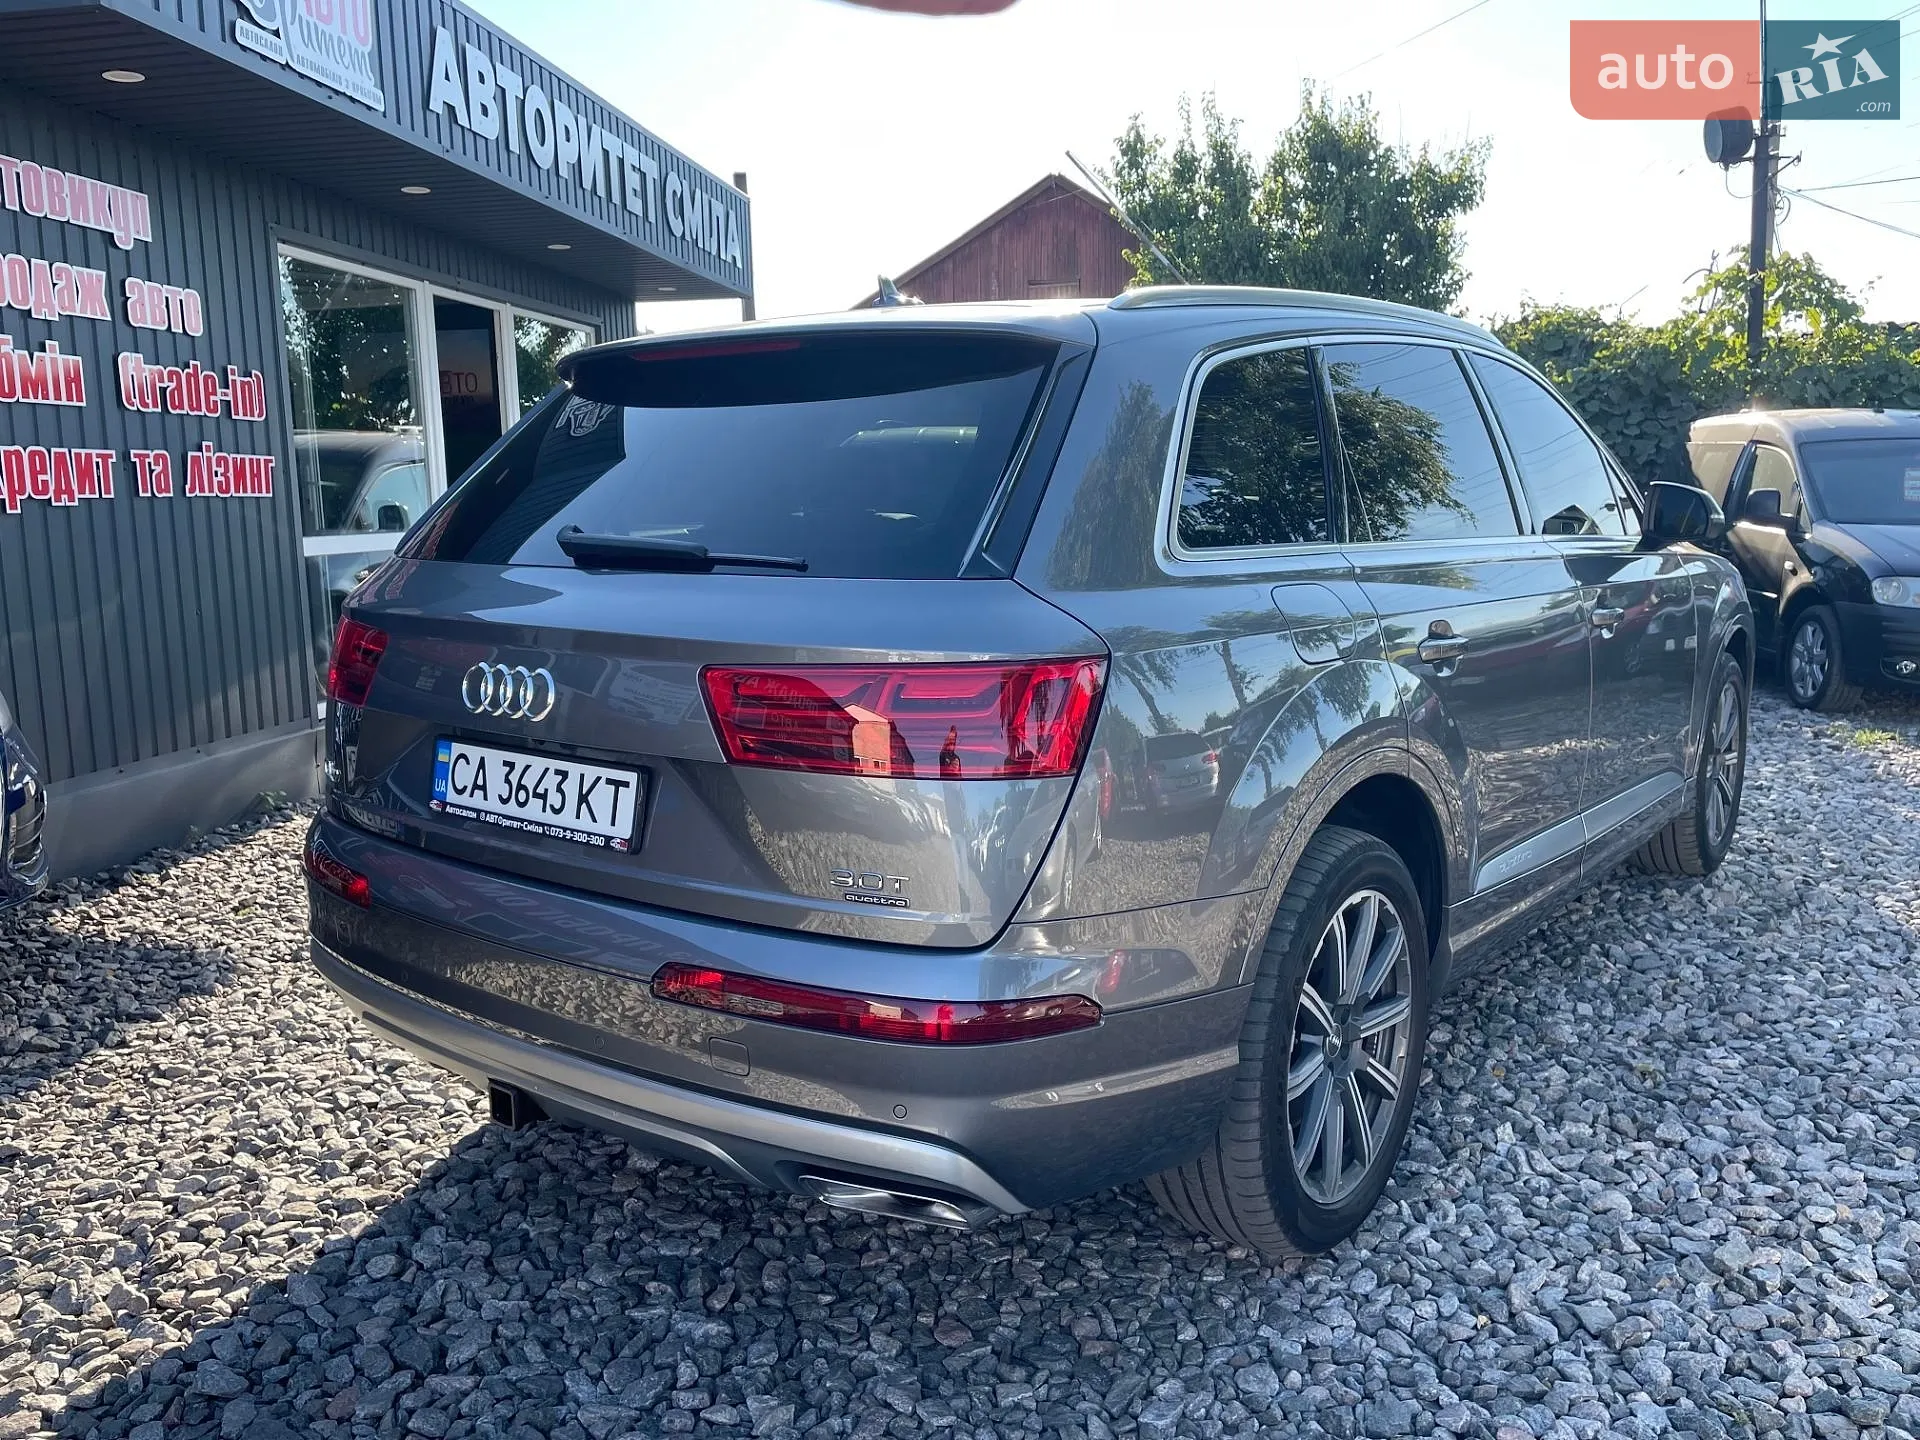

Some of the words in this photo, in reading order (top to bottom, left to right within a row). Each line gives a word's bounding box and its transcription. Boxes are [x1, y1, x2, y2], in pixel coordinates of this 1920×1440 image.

[429, 26, 658, 224] АВТОРИТЕТ
[665, 171, 743, 269] СМІЛА
[0, 153, 153, 250] товикуп
[124, 277, 204, 337] авто
[117, 351, 267, 421] (trade-in)
[0, 445, 117, 514] редит
[130, 449, 174, 497] та
[185, 441, 276, 497] лізинг
[434, 778, 447, 793] UA
[451, 752, 489, 802] CA
[497, 760, 569, 816] 3643
[575, 772, 631, 827] KT
[445, 805, 477, 819] Автосалон
[550, 828, 605, 847] 073-9-300-300
[845, 894, 906, 908] quattro
